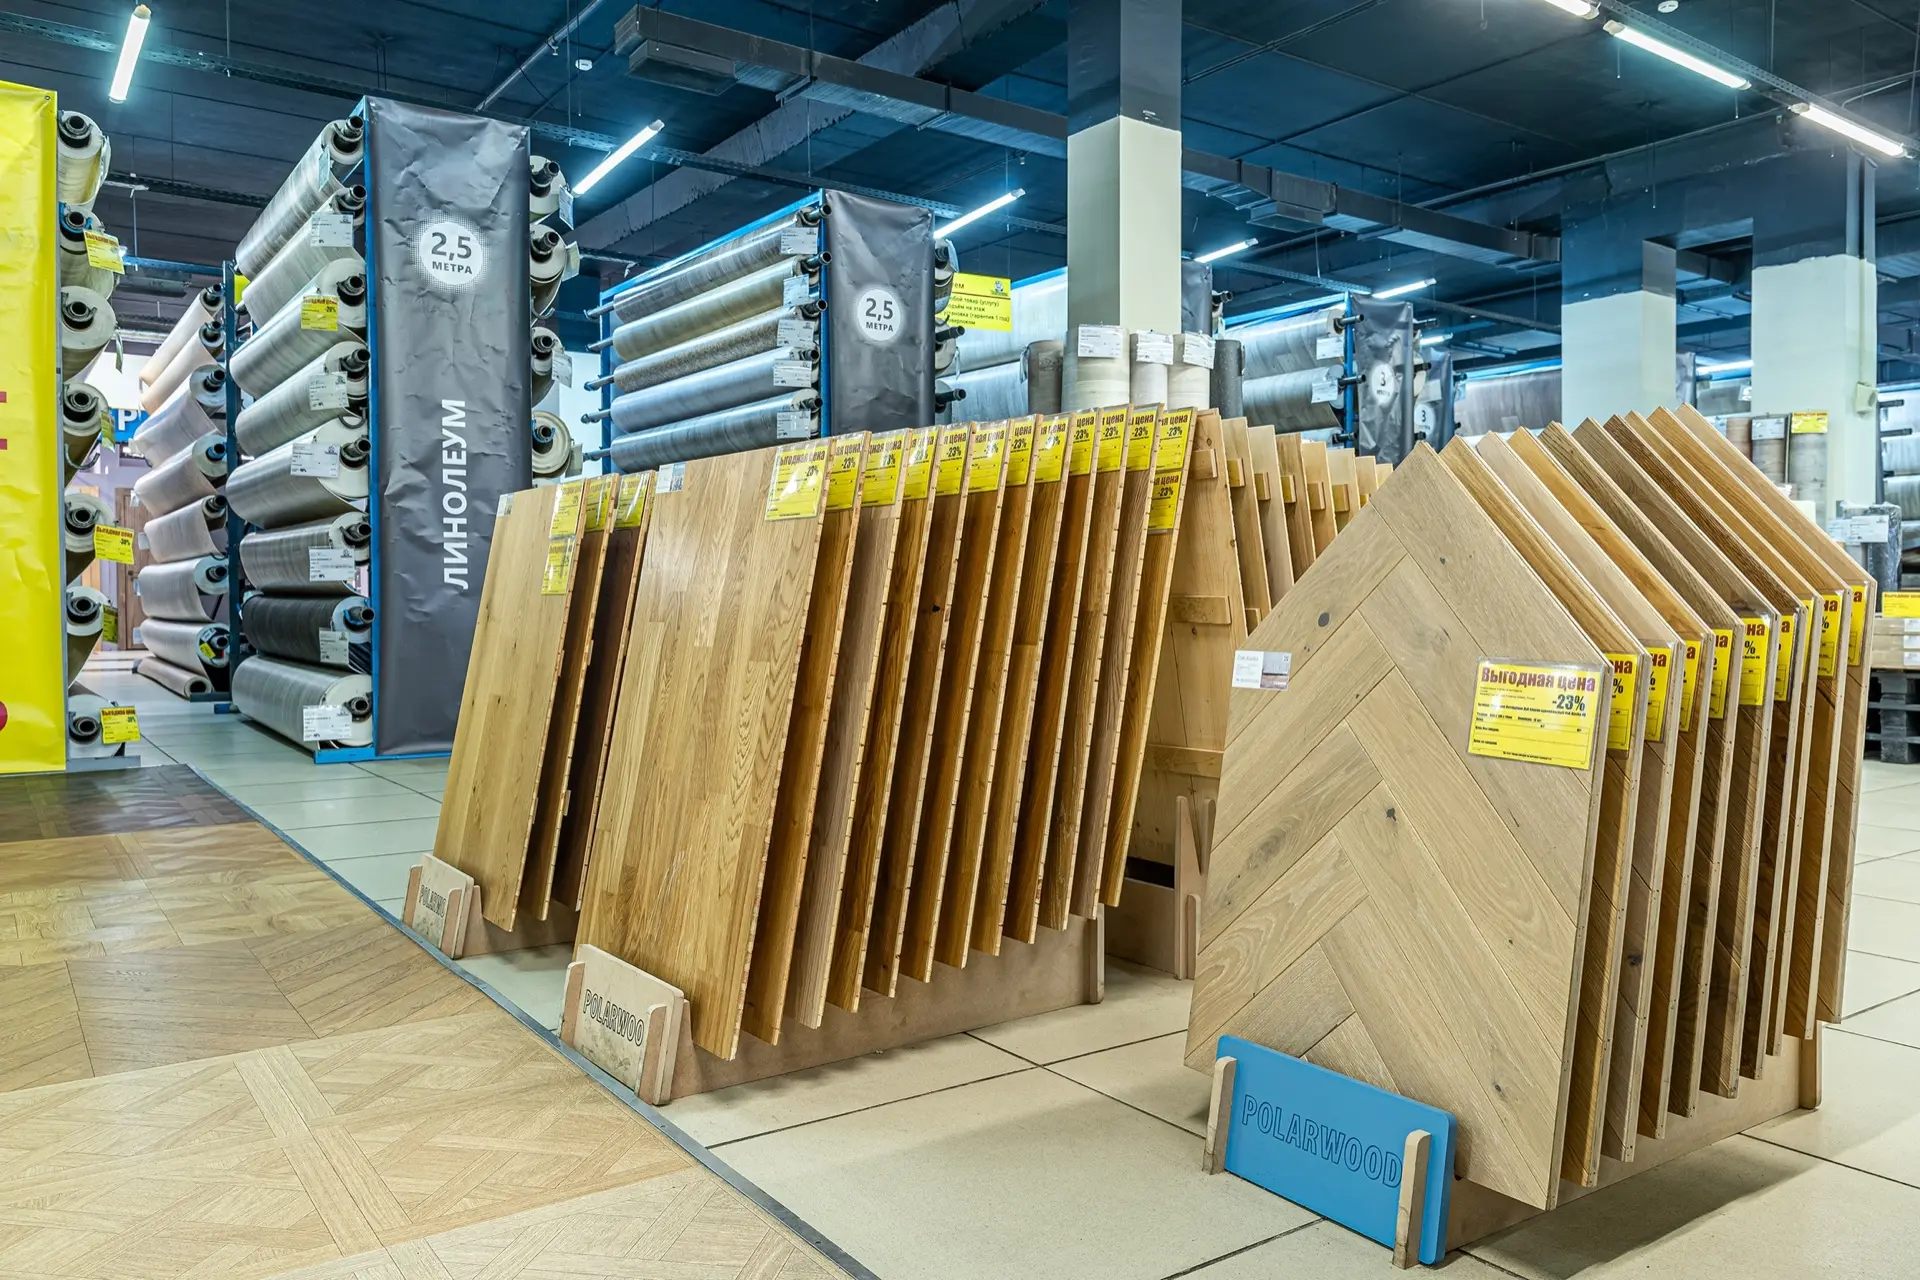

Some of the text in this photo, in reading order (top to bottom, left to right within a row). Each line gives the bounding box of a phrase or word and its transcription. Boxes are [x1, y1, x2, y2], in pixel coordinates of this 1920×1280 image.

[431, 232, 472, 261] 2,5
[432, 261, 473, 275] МЕТРА
[865, 297, 894, 322] 2,5
[866, 321, 894, 332] МЕТРА
[1381, 372, 1386, 387] 3
[1076, 416, 1095, 428] цена
[1106, 413, 1125, 426] цена
[1135, 413, 1154, 426] цена
[1169, 414, 1189, 427] цена
[1421, 410, 1427, 422] 3
[1014, 425, 1032, 437] цена
[1048, 423, 1067, 437] цена
[1073, 429, 1089, 441] -23%
[1102, 426, 1119, 438] -23%
[1131, 426, 1149, 438] -23%
[1166, 425, 1183, 437] -23%
[949, 432, 967, 446] цена
[1011, 438, 1027, 450] -23%
[946, 446, 962, 458] -23%
[841, 456, 856, 469] -23%
[1160, 474, 1179, 487] цена
[441, 399, 469, 590] ЛИНОЛЕУМ
[1157, 486, 1174, 498] -23%
[1481, 667, 1555, 688] Выгодная
[1557, 675, 1597, 693] цена
[1552, 693, 1586, 712] -23%
[583, 988, 645, 1047] POLARWOO
[1241, 1094, 1403, 1189] POLARWOOD
